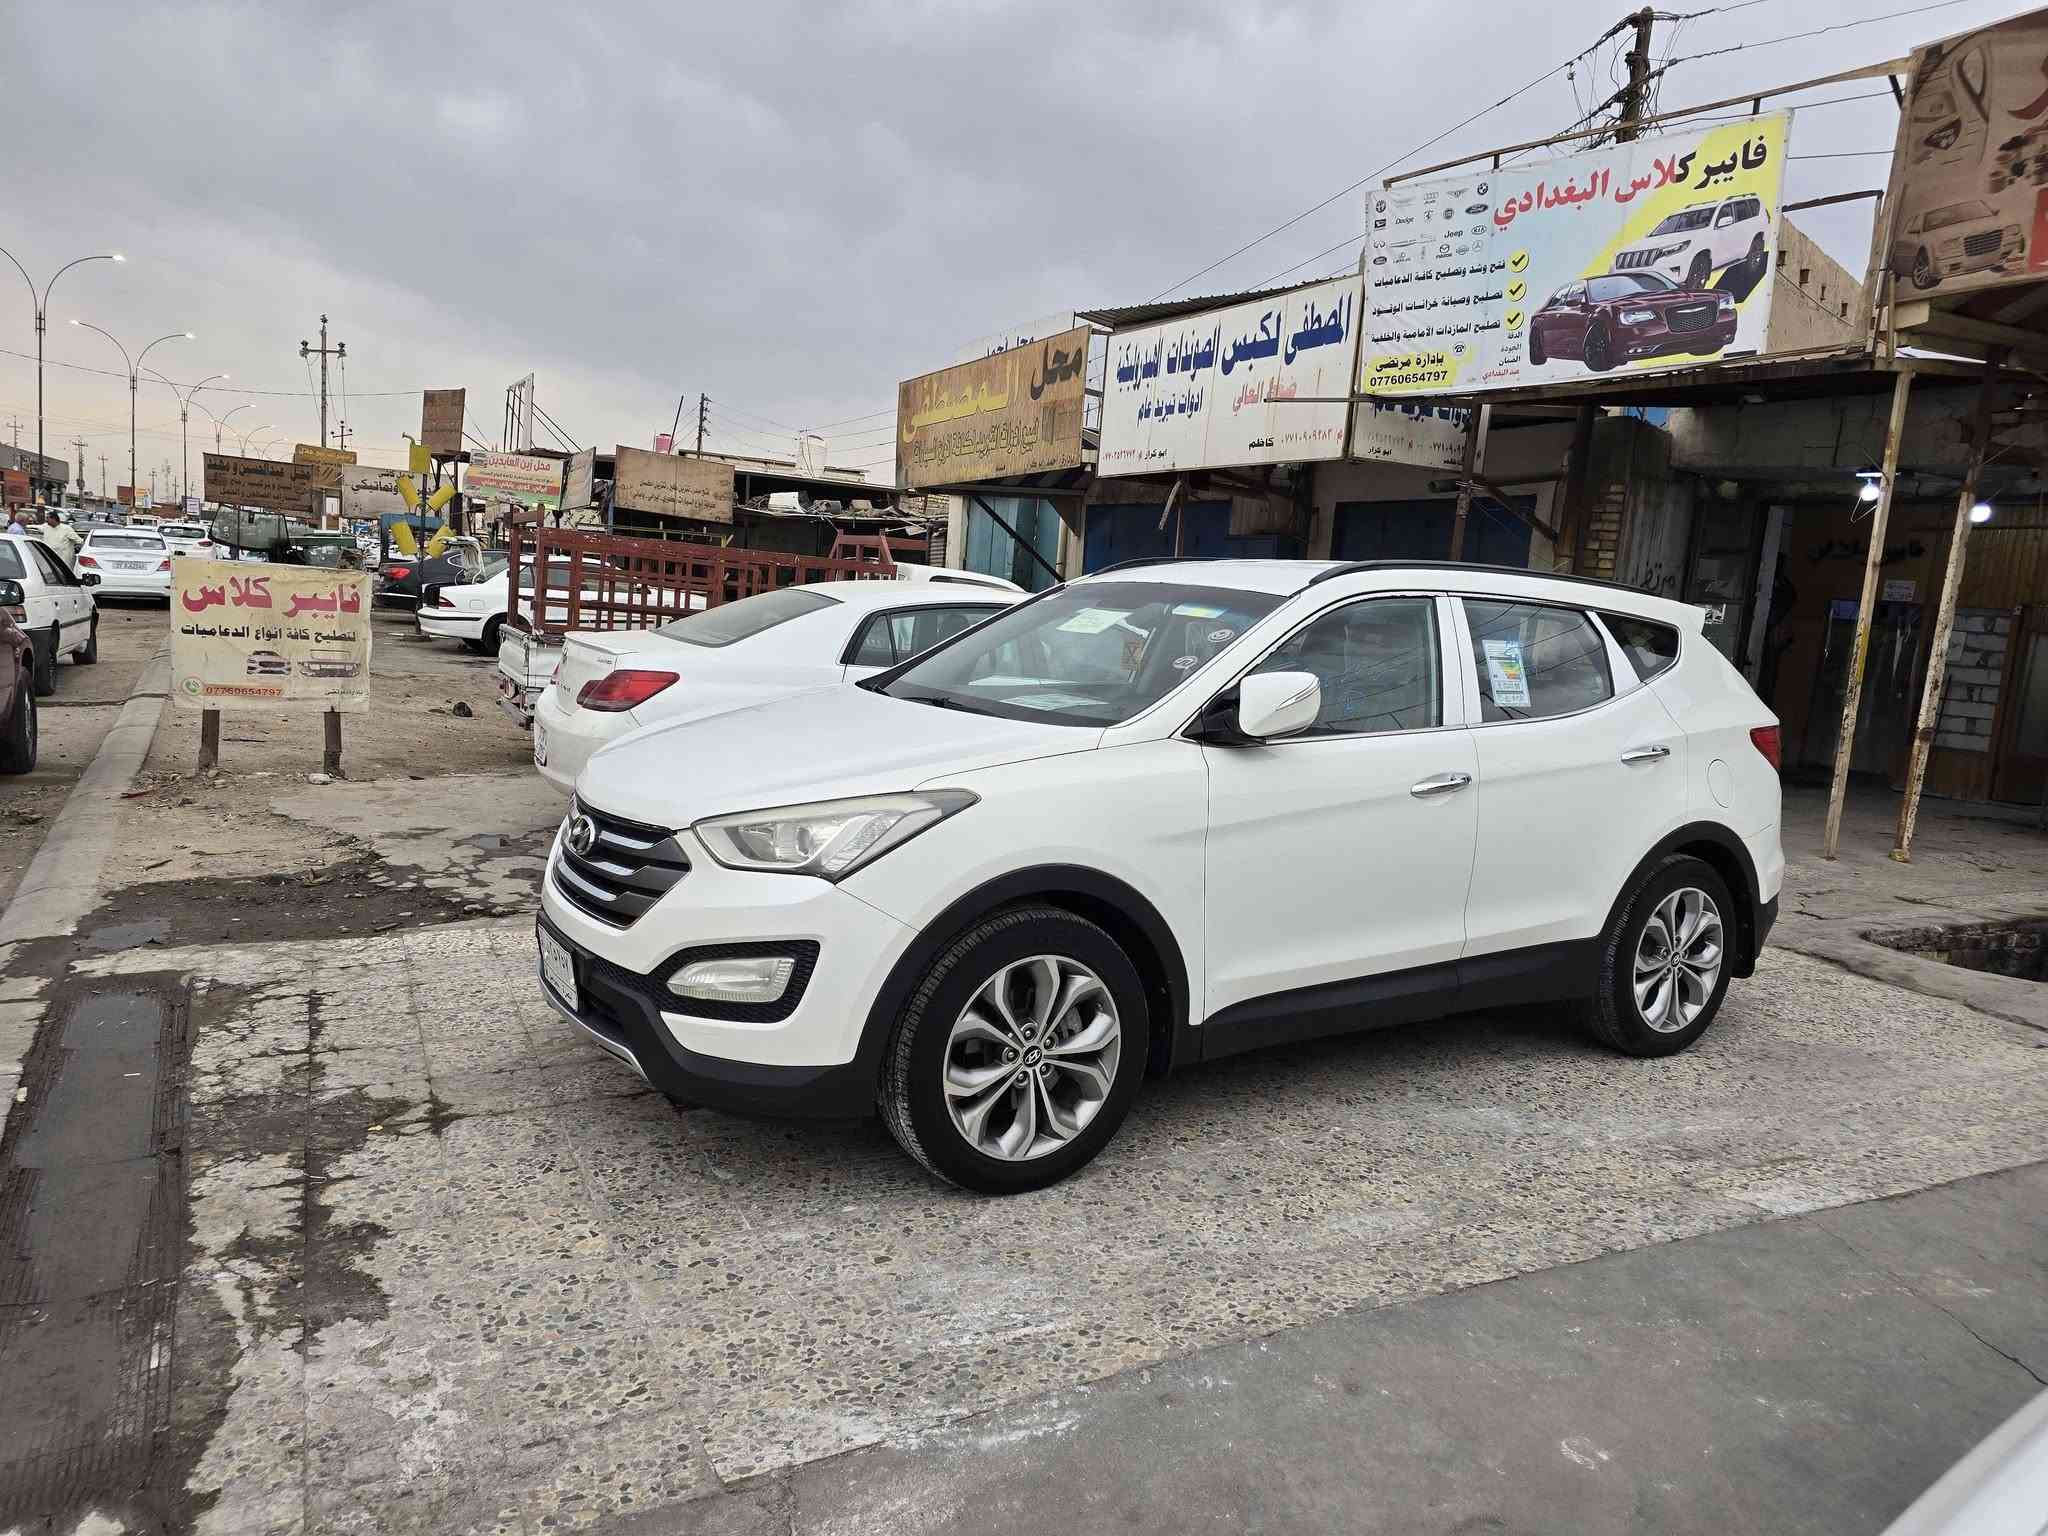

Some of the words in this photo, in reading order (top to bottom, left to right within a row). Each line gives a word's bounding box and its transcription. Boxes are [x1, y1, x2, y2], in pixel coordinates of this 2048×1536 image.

[1694, 135, 1767, 190] فايبر
[1614, 151, 1696, 203] كلاس
[1493, 168, 1610, 231] البغدادي
[1444, 230, 1463, 239] Jeep
[1374, 273, 1412, 288] الدعاميات
[1435, 265, 1467, 281] وتصليح
[1473, 289, 1502, 304] تصليح
[1284, 291, 1353, 366] المصطفى
[1473, 319, 1500, 334] تصليح
[1221, 310, 1281, 376] لكبس
[1030, 339, 1083, 401] محل
[1376, 356, 1411, 372] مرتضى
[1370, 371, 1447, 387] 07760654797
[1178, 385, 1203, 419] ادوات
[533, 459, 551, 472] محل
[181, 575, 272, 612] كلاس
[283, 583, 361, 619] فايبر
[181, 624, 249, 639] الدعاميات
[254, 626, 282, 642] انواع
[286, 627, 310, 641] كافة
[314, 629, 356, 643] لتصليح
